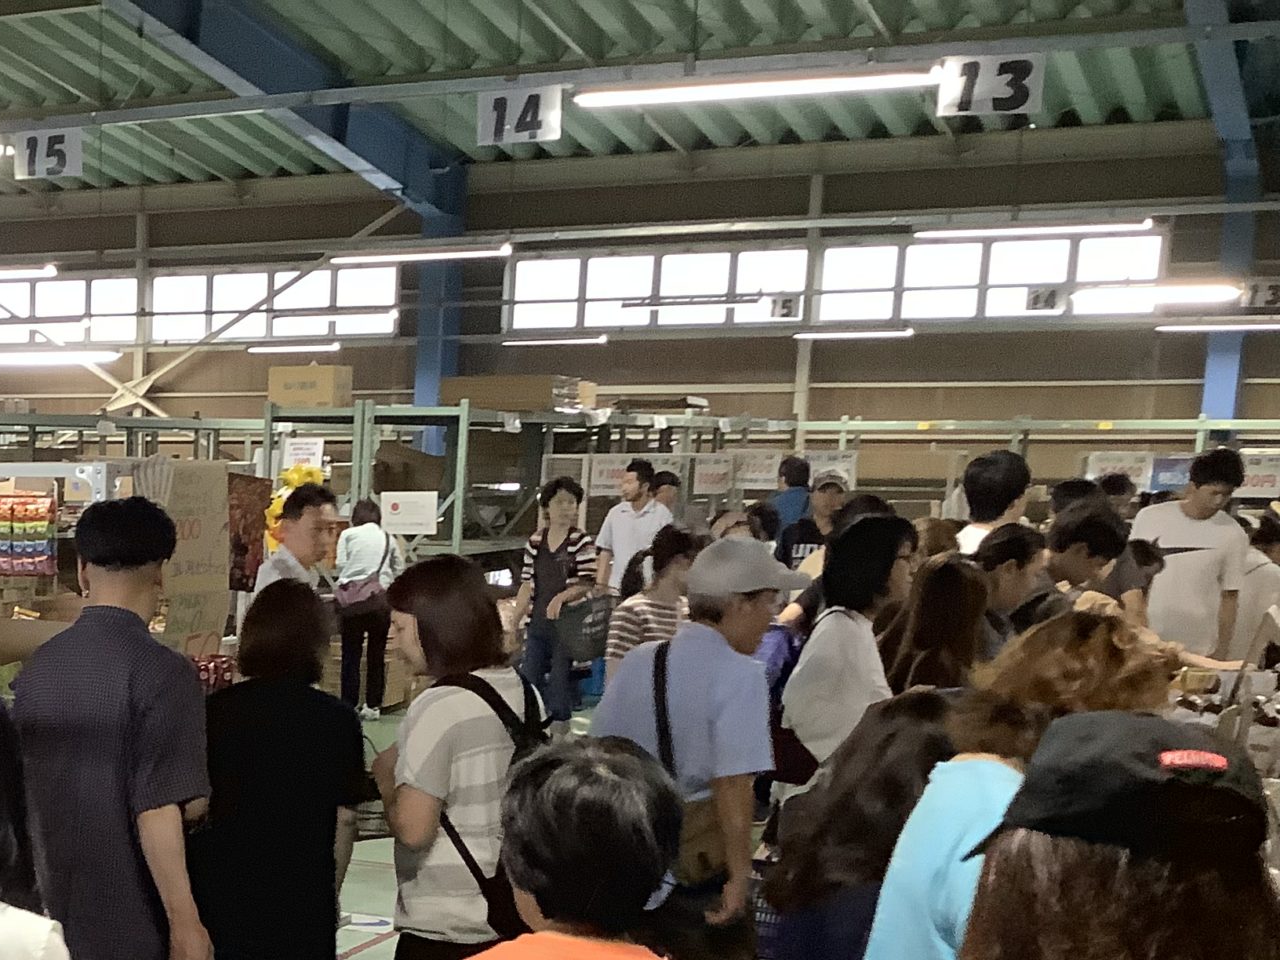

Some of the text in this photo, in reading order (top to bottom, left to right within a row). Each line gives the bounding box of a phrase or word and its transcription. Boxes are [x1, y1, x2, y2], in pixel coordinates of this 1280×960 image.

[958, 59, 1034, 112] 13
[493, 93, 542, 142] 14
[26, 134, 67, 176] 15
[771, 299, 793, 317] 15
[1248, 283, 1280, 305] 13
